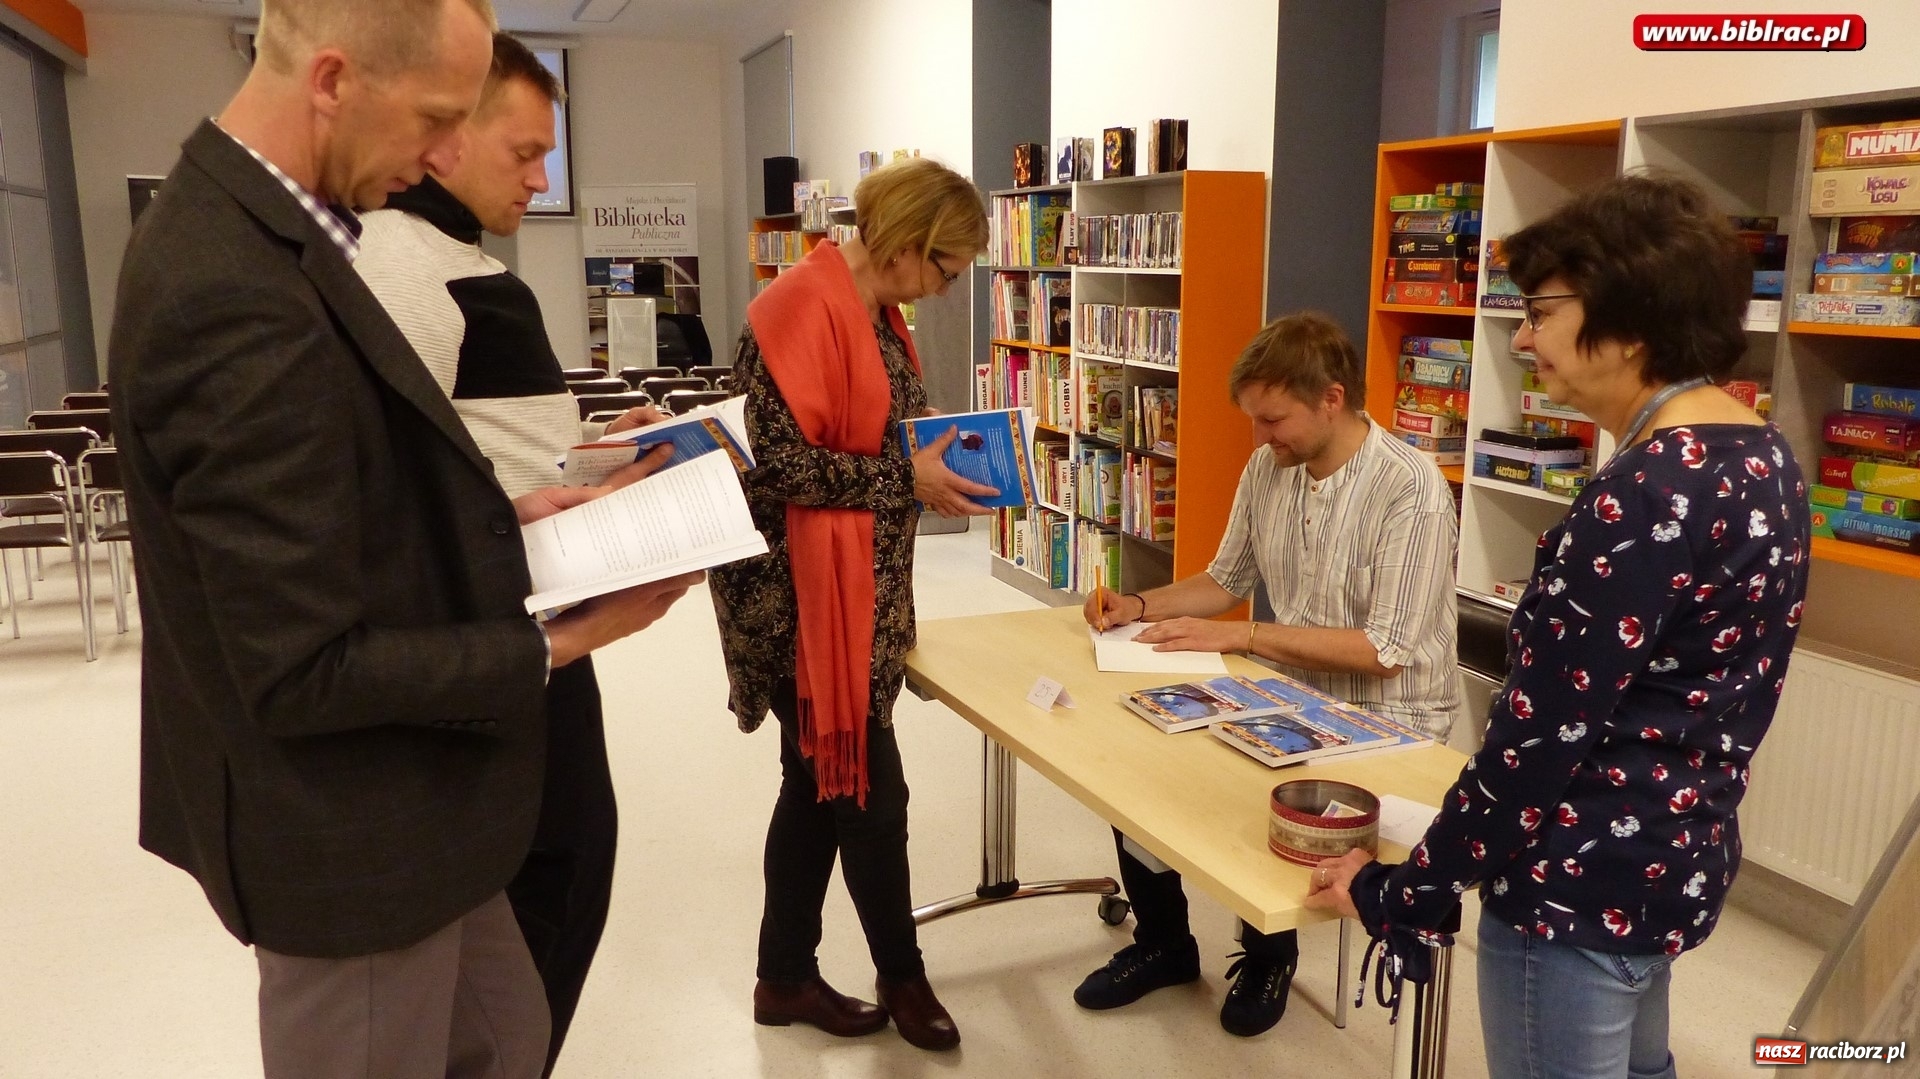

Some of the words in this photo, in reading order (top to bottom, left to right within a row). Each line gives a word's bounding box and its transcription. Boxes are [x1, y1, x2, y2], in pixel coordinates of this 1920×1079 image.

[1870, 191, 1899, 204] LOSU
[594, 206, 686, 227] Biblioteka
[631, 228, 680, 240] Publiczna
[1407, 260, 1441, 272] Czarownice
[1063, 381, 1071, 415] HOBBY
[1830, 425, 1877, 440] TAJNIACY
[1843, 518, 1870, 531] BITWA
[1872, 523, 1912, 541] MORSKA
